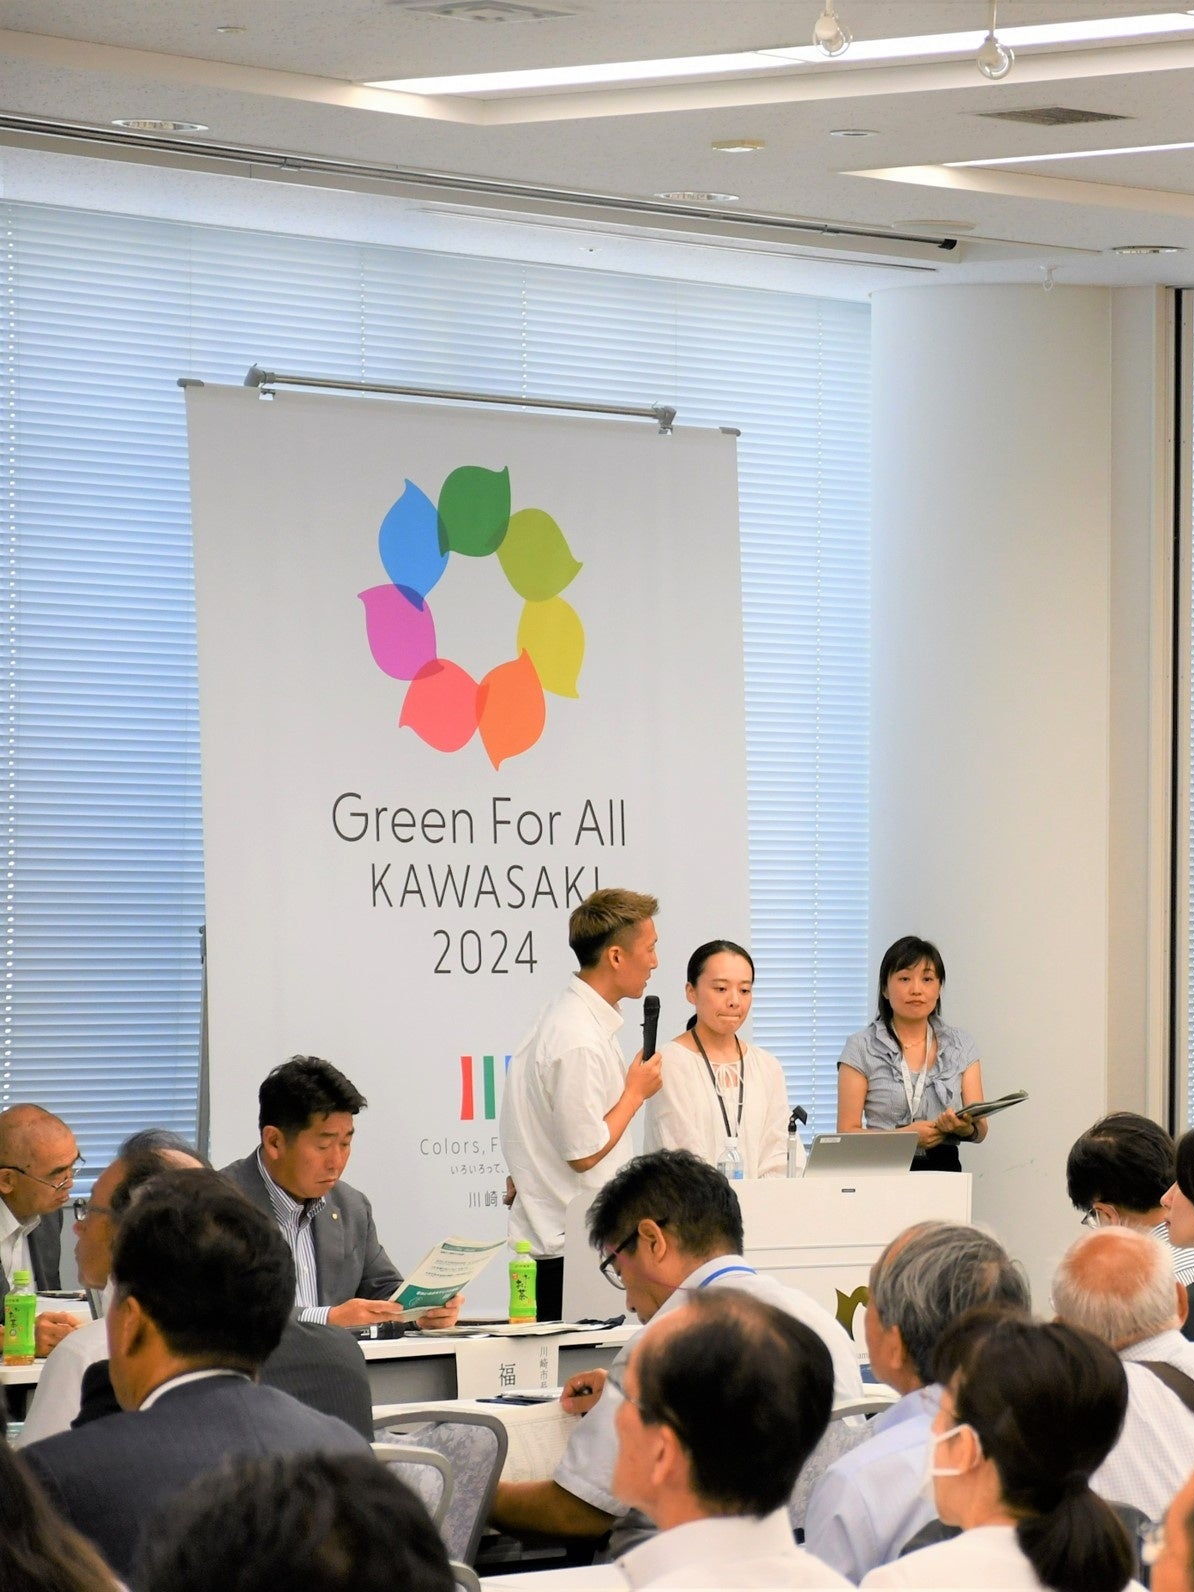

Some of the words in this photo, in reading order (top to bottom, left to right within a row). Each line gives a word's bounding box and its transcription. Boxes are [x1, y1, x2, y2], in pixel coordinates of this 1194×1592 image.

[331, 792, 474, 844] Green
[492, 796, 561, 846] For
[576, 799, 625, 847] All
[371, 862, 600, 909] KAWASAKI
[433, 929, 539, 976] 2024
[420, 1137, 486, 1155] Colors,
